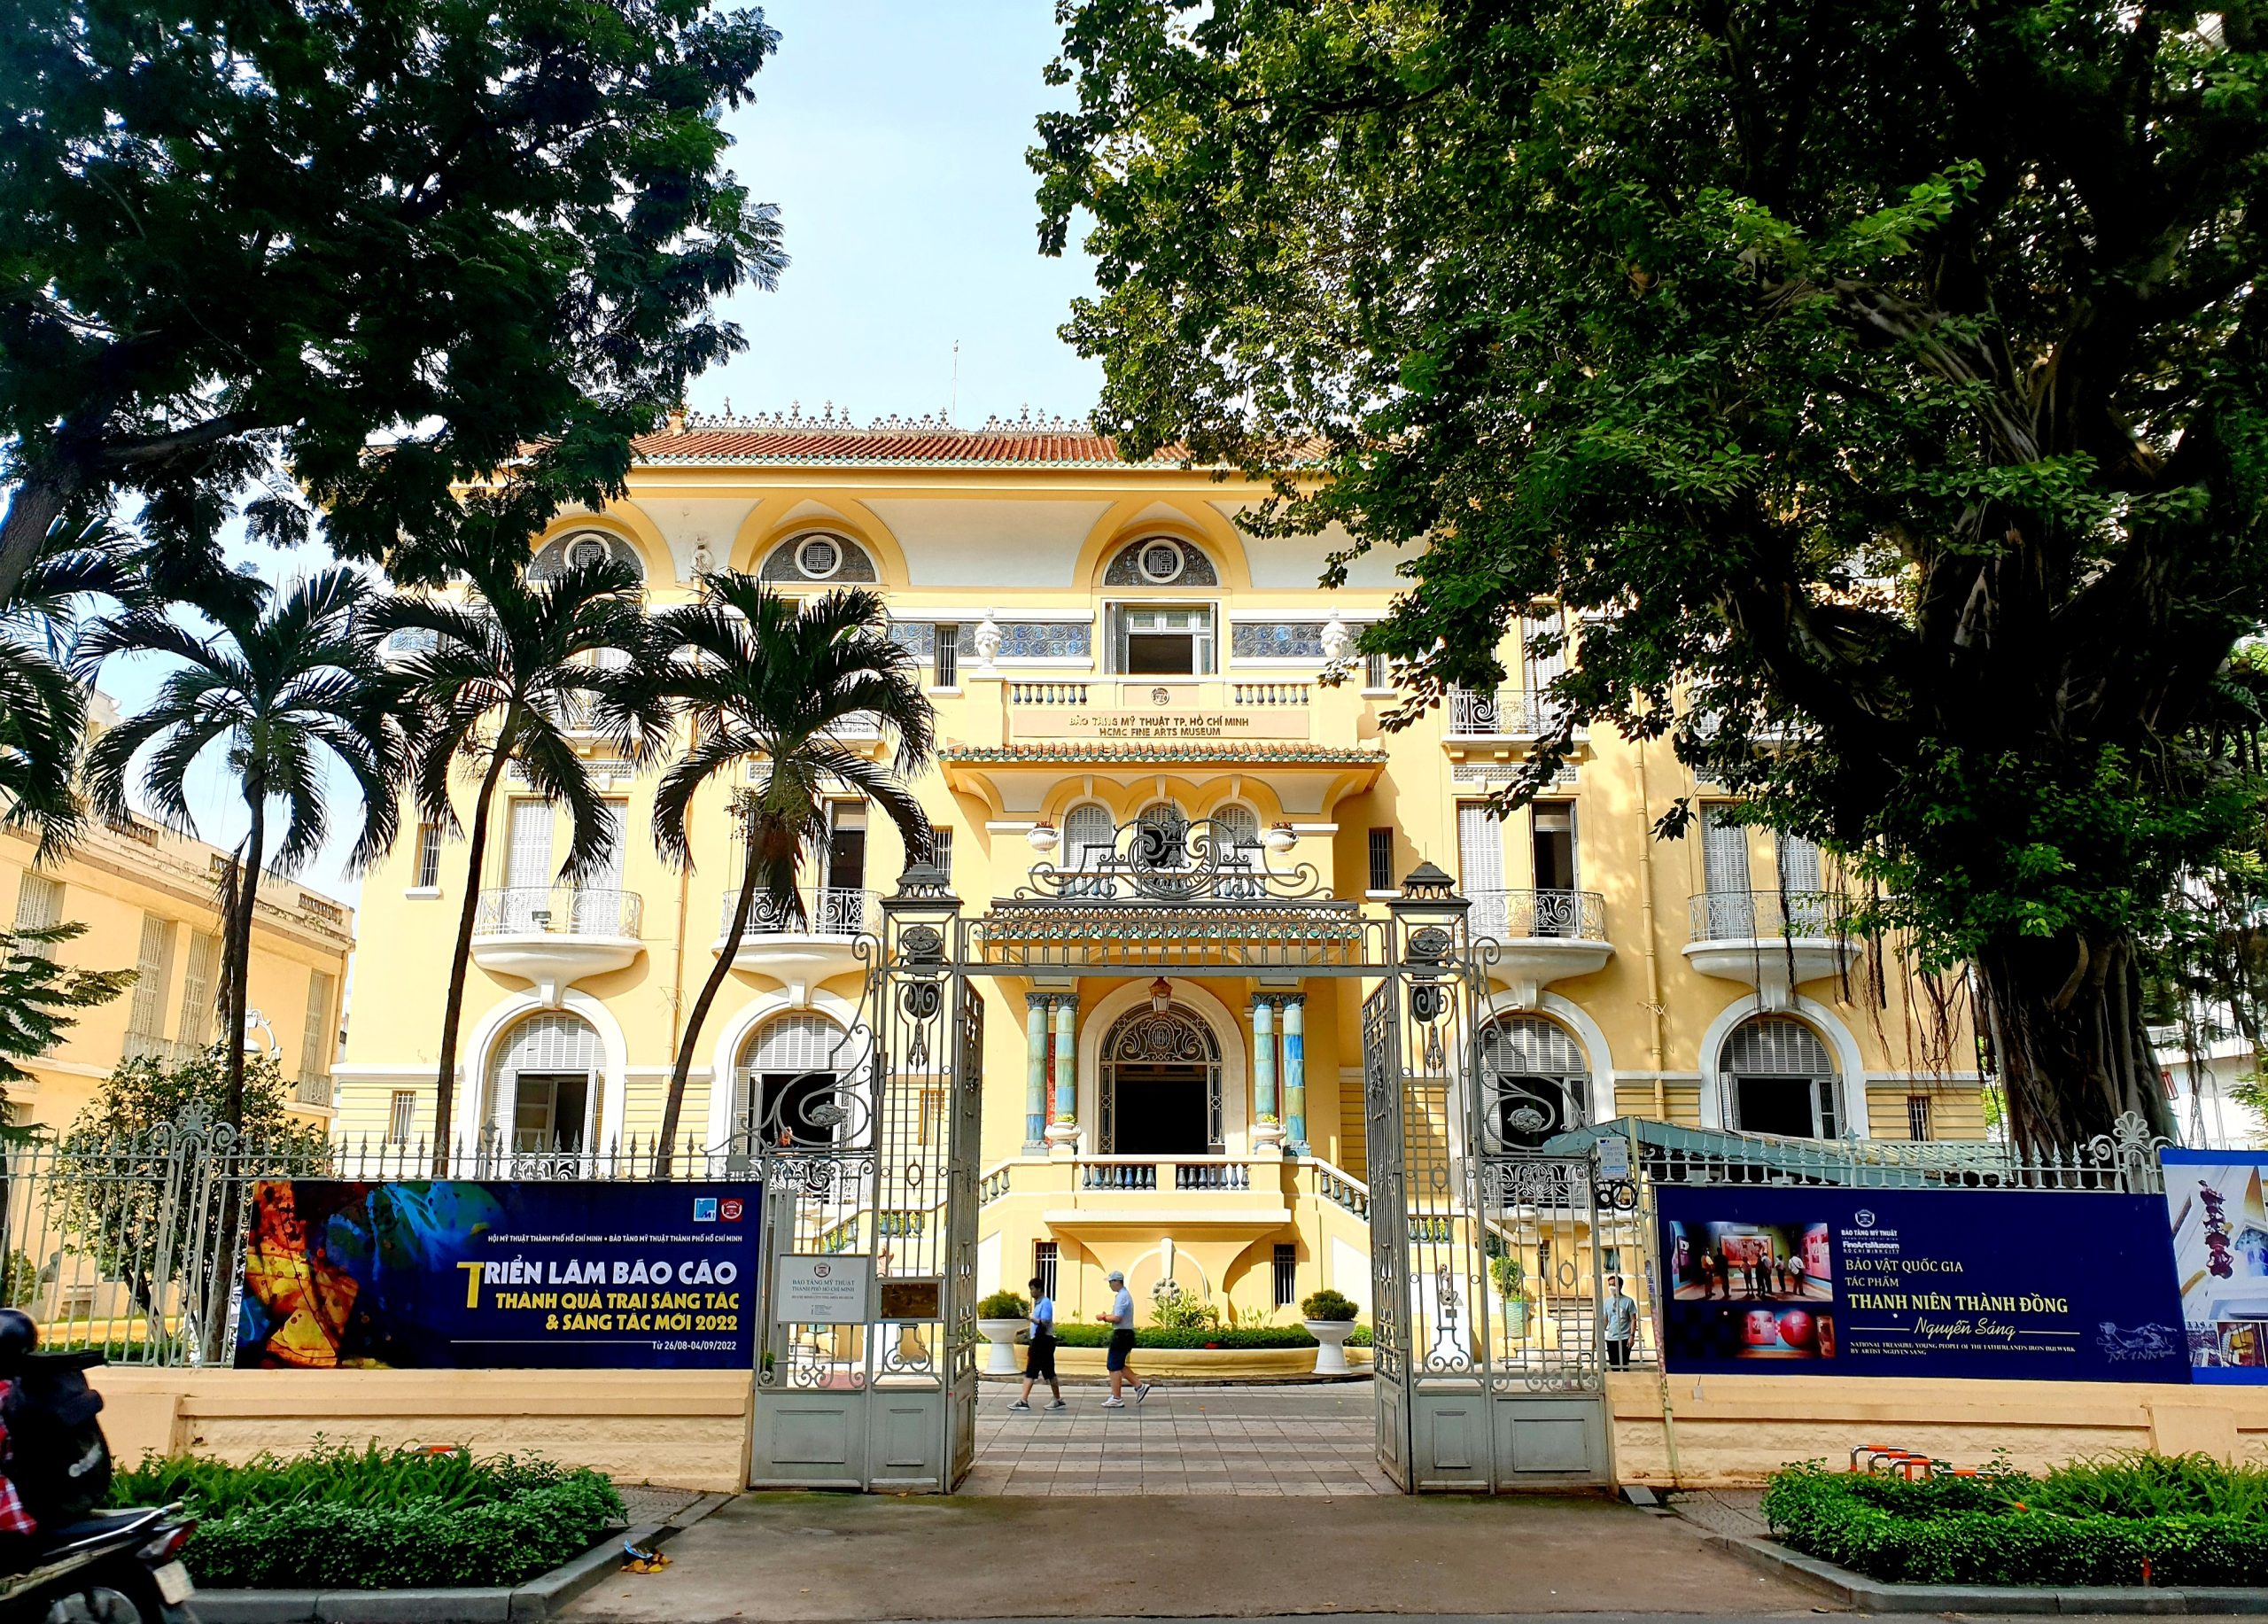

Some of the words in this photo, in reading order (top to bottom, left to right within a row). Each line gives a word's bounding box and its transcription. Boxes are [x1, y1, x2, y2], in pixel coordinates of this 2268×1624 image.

[1121, 715, 1135, 726] MỸ
[1139, 715, 1169, 727] THUẬT
[1174, 718, 1186, 727] TP.
[1190, 714, 1203, 726] HỒ
[1207, 715, 1223, 726] CHÍ
[1224, 718, 1249, 727] MINH
[1180, 727, 1221, 736] MUSEUM
[488, 1234, 499, 1243] HỘI
[509, 1234, 529, 1243] THUẬT
[649, 1234, 669, 1243] THUẬT
[1845, 1257, 1872, 1270] BẢO
[1874, 1258, 1899, 1273] VẬT
[1902, 1258, 1938, 1273] QUỐC
[1940, 1261, 1963, 1272] GIA
[456, 1255, 542, 1309] TRIỂN
[548, 1259, 606, 1284] LÃM
[612, 1259, 672, 1285] BÁO
[679, 1259, 737, 1285] CÁO
[1845, 1276, 1865, 1286] TÁC
[1868, 1276, 1899, 1286] PHẨM
[495, 1291, 555, 1309] THÀNH
[561, 1289, 603, 1309] QUẢ
[607, 1293, 648, 1311] TRẠI
[651, 1291, 701, 1309] SÁNG
[705, 1291, 740, 1309] TÁC
[1847, 1294, 1907, 1309] THANH
[1911, 1292, 1952, 1310] NIÊN
[1955, 1293, 2016, 1311] THÀNH
[2019, 1292, 2069, 1313] ĐỒNG
[546, 1315, 559, 1330] &
[563, 1312, 612, 1331] SÁNG
[617, 1312, 651, 1331] TÁC
[655, 1312, 691, 1331] MỚI
[695, 1315, 738, 1331] 2022
[1914, 1317, 1972, 1340] Nguyễn
[1975, 1317, 2016, 1340] Sáng
[652, 1340, 663, 1350] Từ
[664, 1341, 736, 1351] 26/08-04/09/2022
